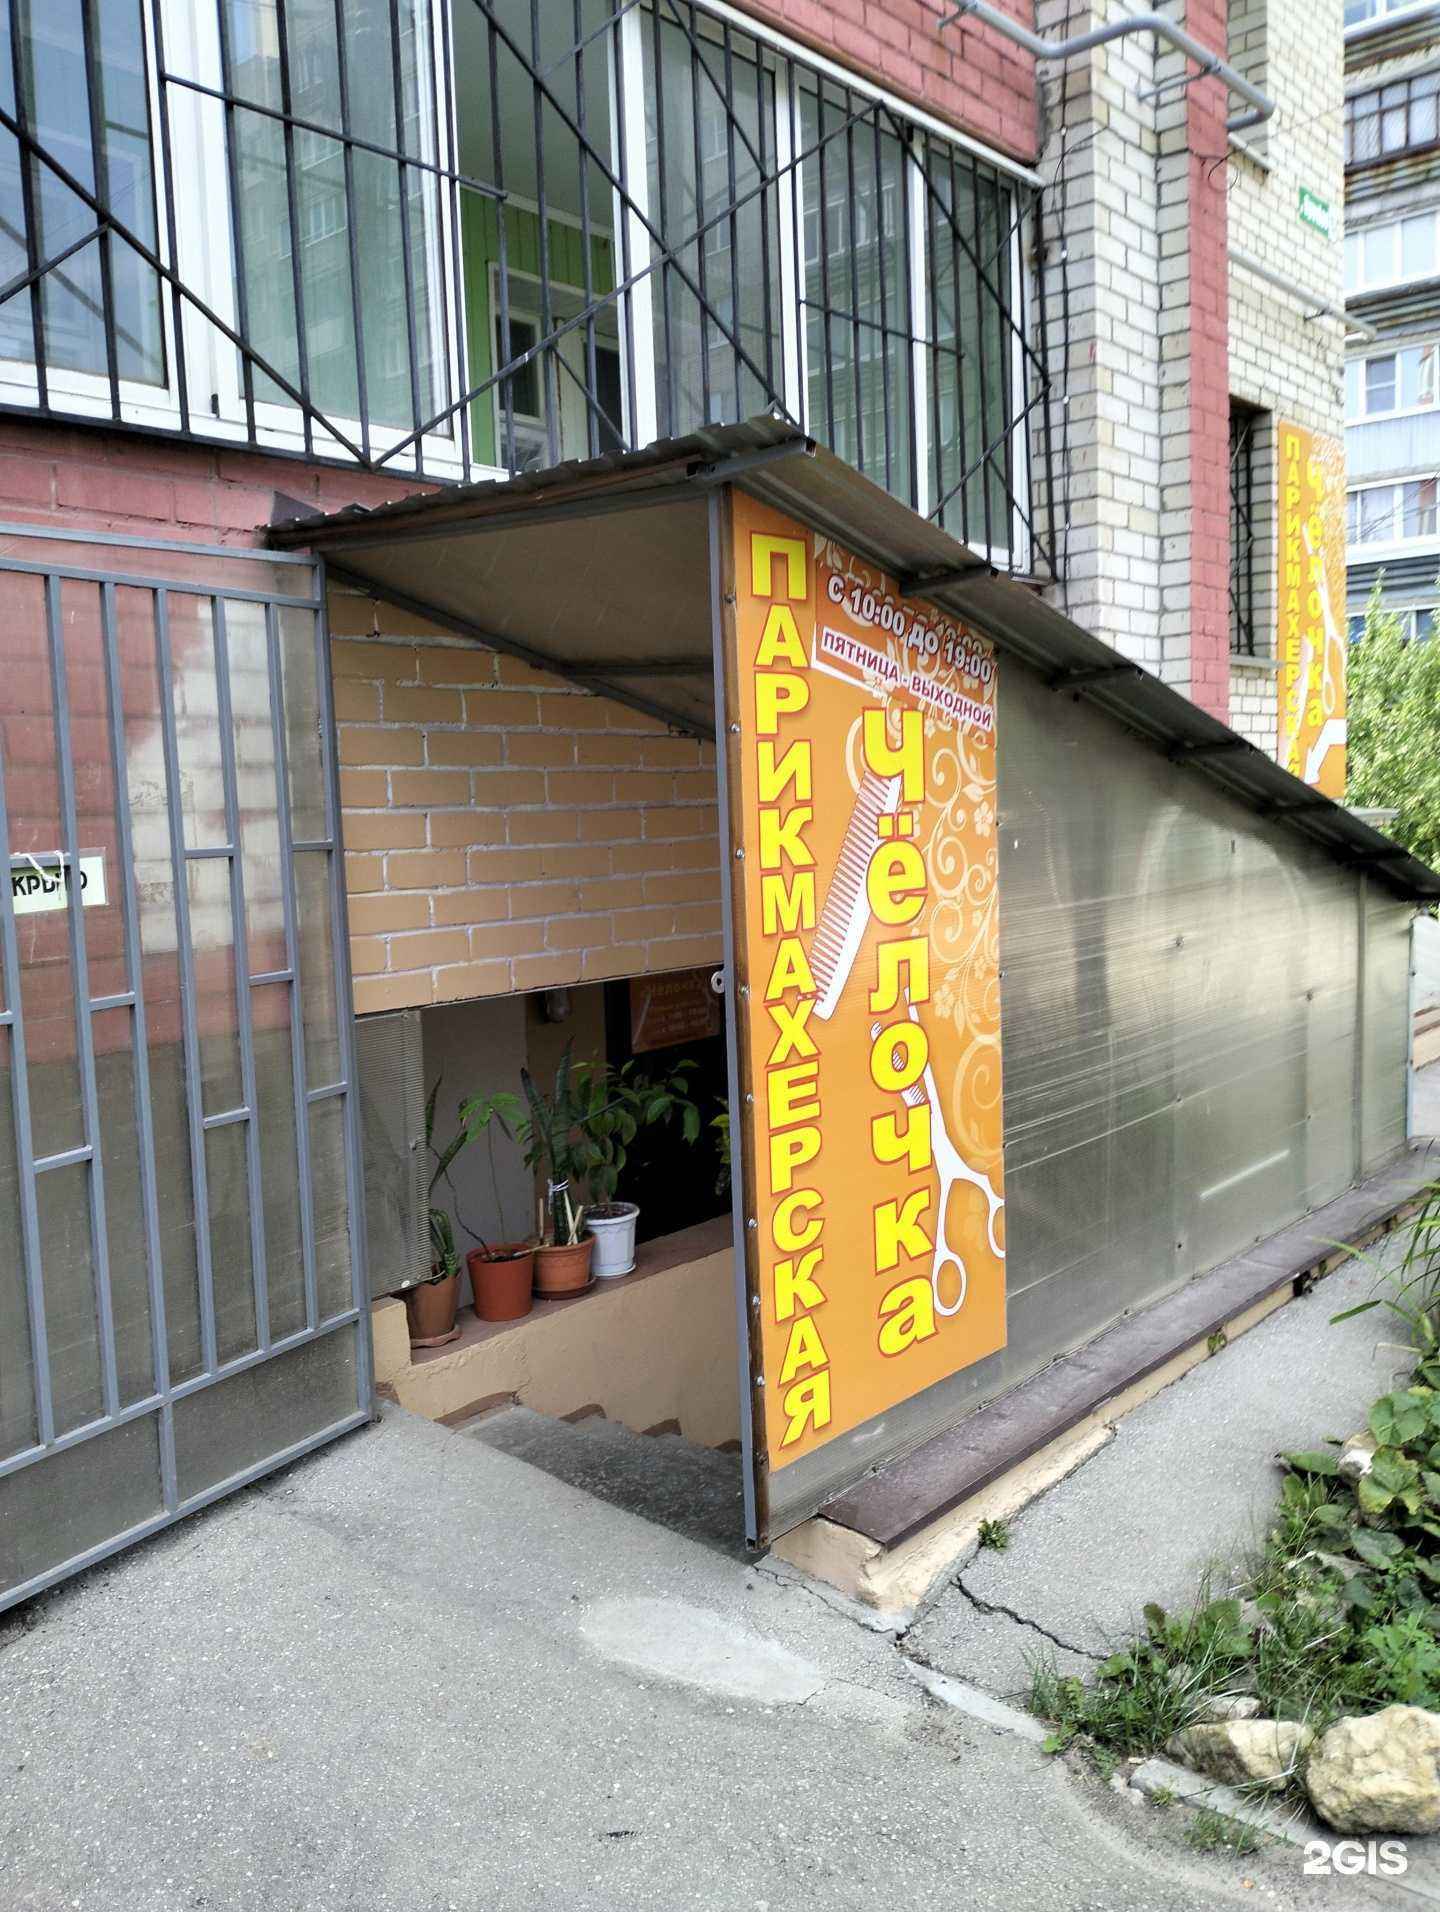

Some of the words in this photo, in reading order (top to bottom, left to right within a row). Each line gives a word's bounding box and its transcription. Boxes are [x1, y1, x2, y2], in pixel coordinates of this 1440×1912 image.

[850, 587, 905, 637] 10:00
[823, 630, 900, 683] ПЯТНИЦА
[911, 675, 992, 729] ВЫХОДНОЙ
[750, 530, 832, 1450] ПАРИКМАХЕРСКАЯ
